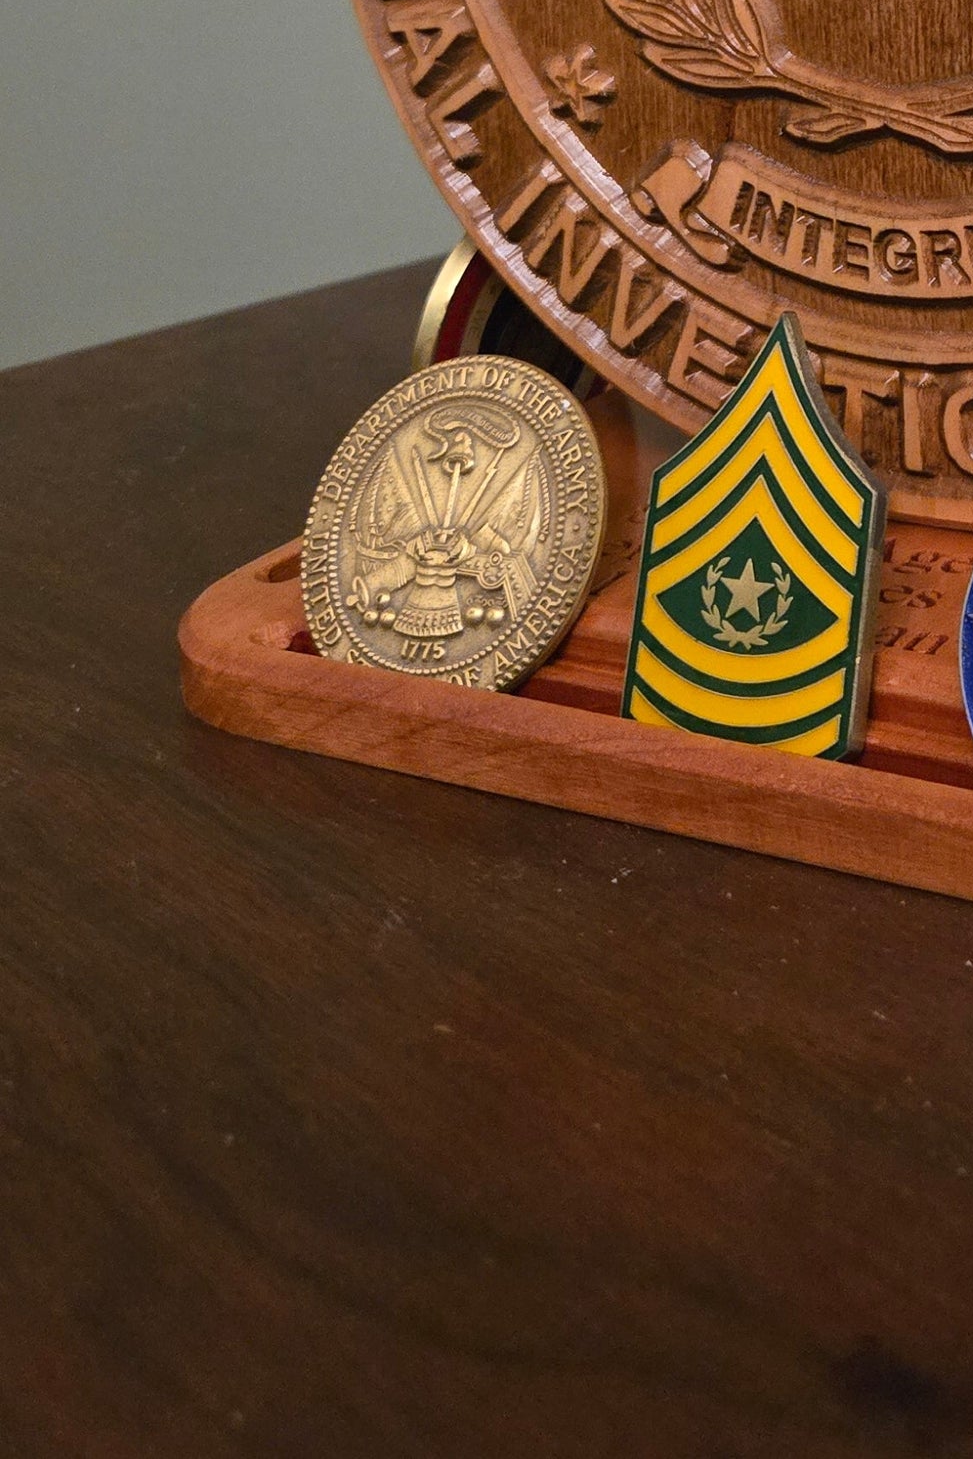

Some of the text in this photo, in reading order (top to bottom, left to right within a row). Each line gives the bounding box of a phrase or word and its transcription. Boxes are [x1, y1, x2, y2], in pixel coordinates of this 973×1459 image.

[322, 365, 591, 515] DEPARTMENT OF THE ARMY
[303, 531, 343, 646] UNITED
[493, 544, 581, 676] AMERICA
[400, 639, 446, 661] 1775
